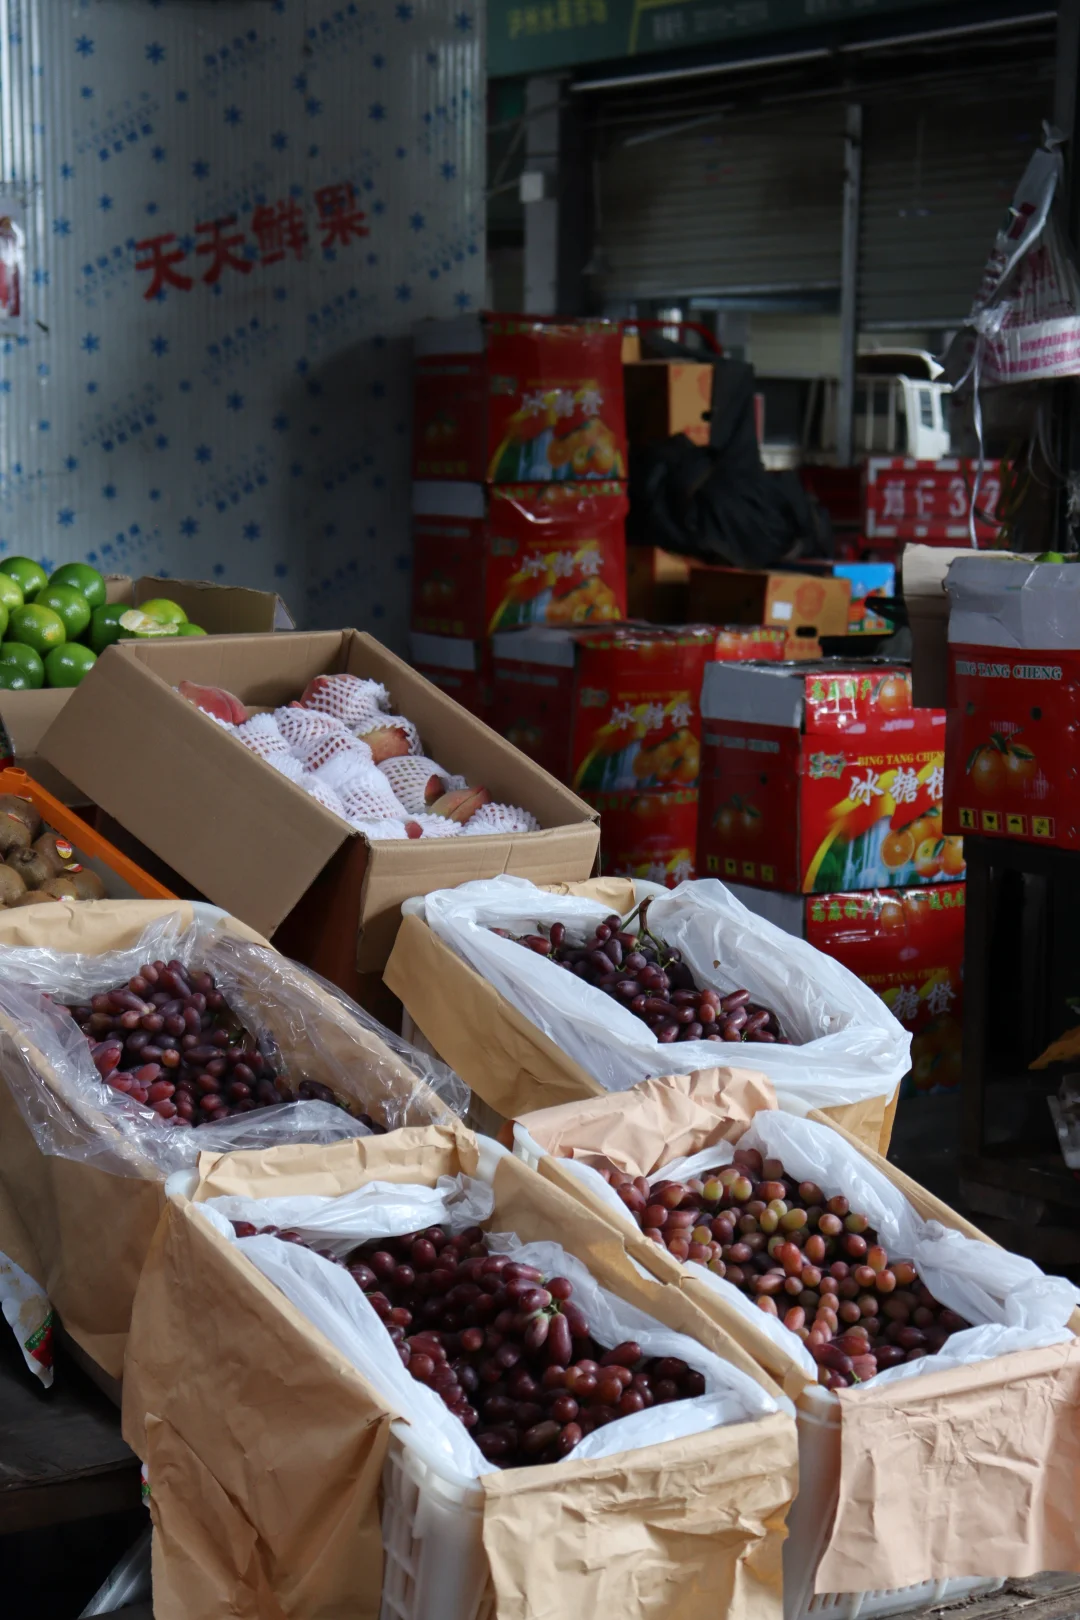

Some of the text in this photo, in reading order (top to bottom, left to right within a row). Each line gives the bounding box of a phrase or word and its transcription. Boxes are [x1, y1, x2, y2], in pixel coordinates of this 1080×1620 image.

[135, 183, 371, 300] 天天鲜果
[978, 664, 1010, 679] TANG
[1012, 666, 1063, 681] CHENG
[857, 755, 883, 767] BING
[886, 753, 914, 765] TANG
[876, 981, 957, 1021] 糖橙
